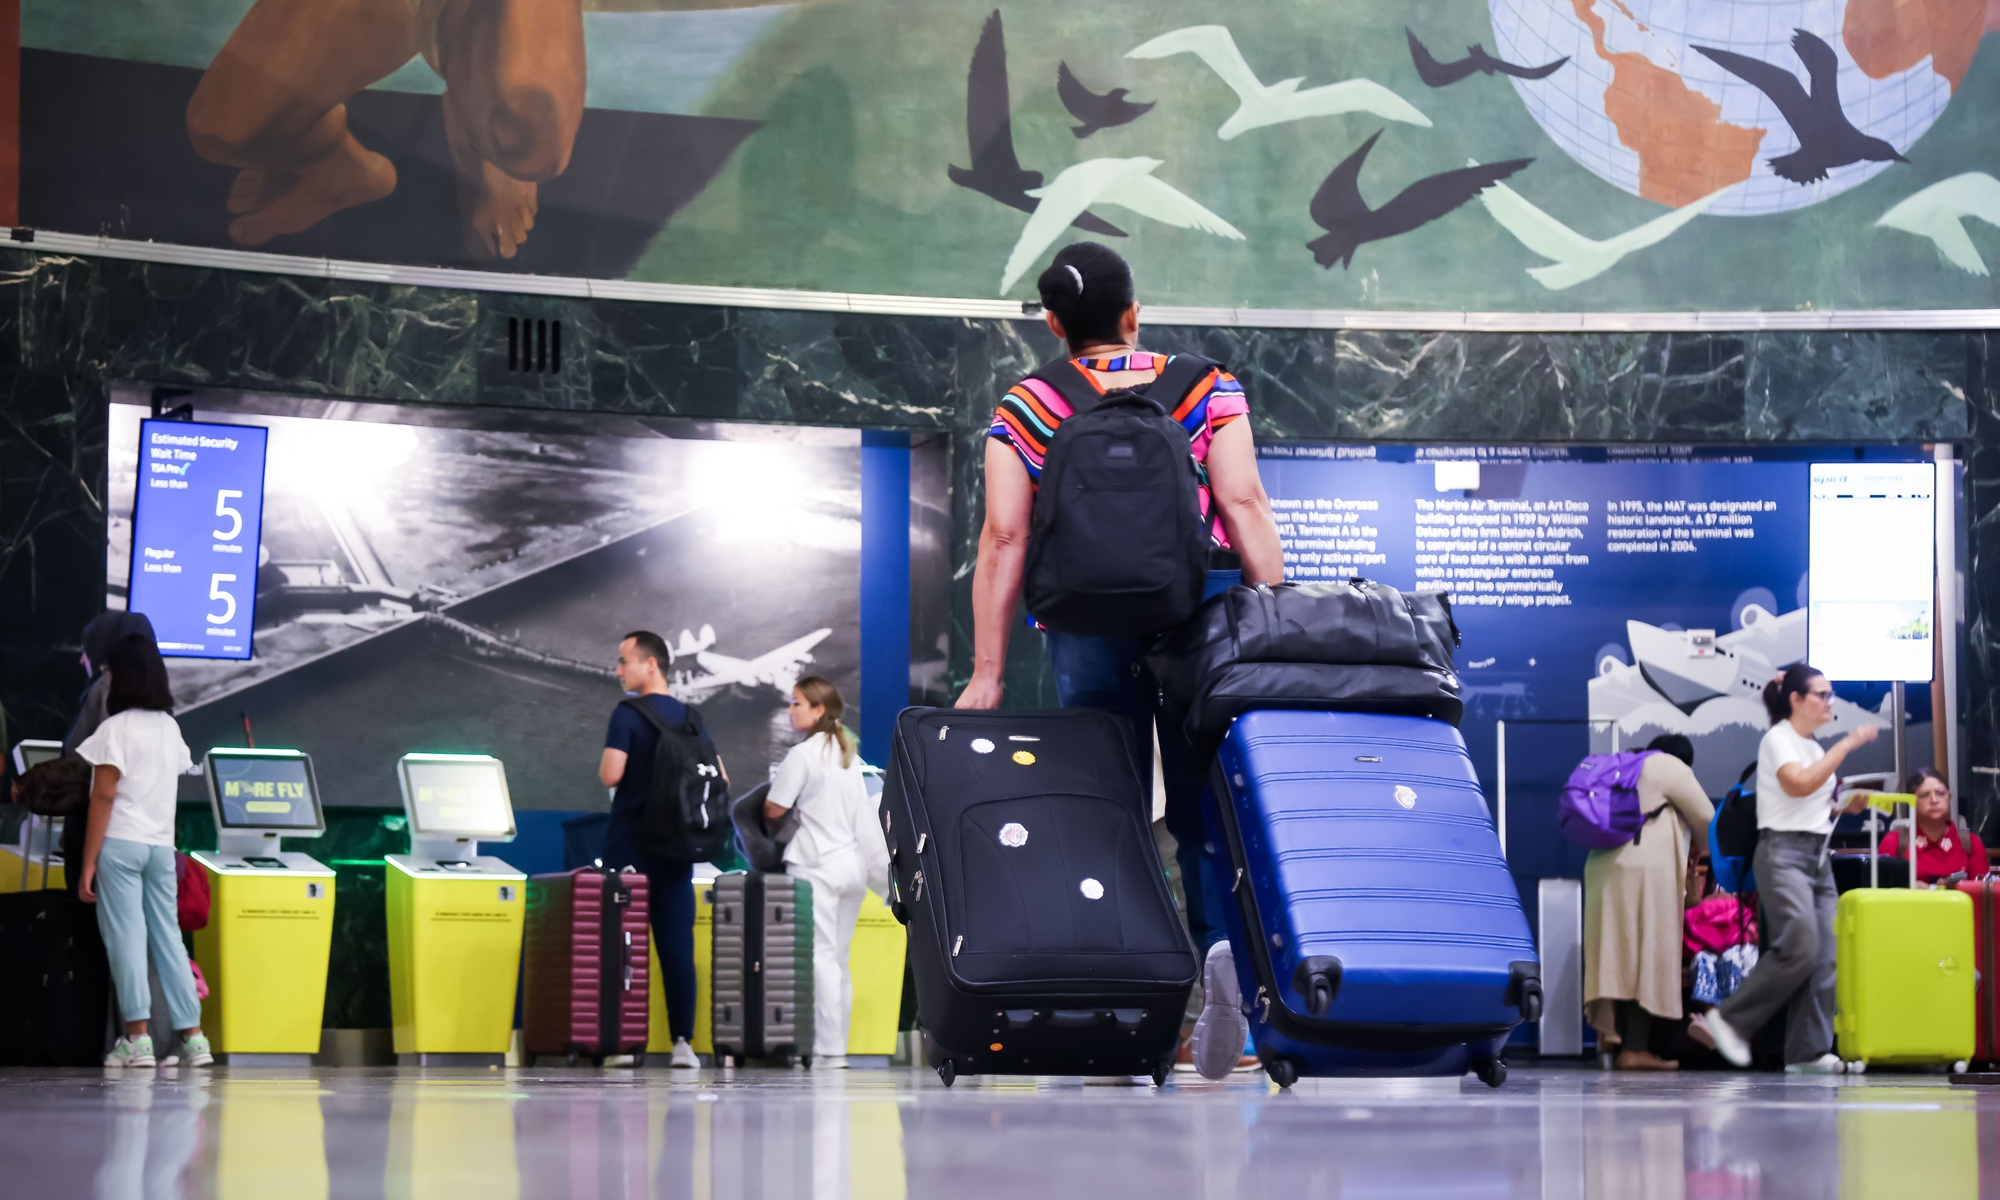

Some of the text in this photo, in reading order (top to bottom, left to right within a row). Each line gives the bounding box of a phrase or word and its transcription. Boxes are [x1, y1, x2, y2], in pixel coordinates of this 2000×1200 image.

[152, 432, 238, 451] Estimated Security
[150, 447, 197, 461] Wait Time
[150, 478, 188, 489] Less than
[1270, 498, 1378, 511] known as the Overseas
[1415, 499, 1589, 512] The Marine Air Terminal, an Art Deco
[1607, 500, 1776, 513] In 1995, the MAT was designated an
[212, 490, 242, 541] 5
[1291, 511, 1308, 523] the
[1309, 512, 1342, 523] Marine
[1344, 512, 1360, 523] Air
[1415, 512, 1588, 526] building designed in 1939 by William
[1607, 513, 1752, 526] historic landmark. A $7 million
[1298, 525, 1340, 536] Terminal
[1341, 526, 1350, 537] A
[1351, 526, 1360, 537] is
[1361, 525, 1378, 537] the
[1416, 526, 1583, 540] Delano of the firm Delano & Aldrich,
[1608, 527, 1754, 539] restoration of the terminal was
[212, 543, 243, 554] minutes
[1295, 538, 1335, 550] terminal
[1336, 538, 1376, 553] building
[1416, 540, 1571, 554] is comprised of a central circular
[1608, 541, 1697, 554] completed in 2004.
[144, 547, 176, 560] Regular
[1284, 552, 1386, 566] the only active airport
[1416, 554, 1589, 565] core of two stories with an attic from
[144, 562, 182, 574] Less than
[1296, 566, 1319, 576] from
[1321, 566, 1337, 577] the
[1338, 566, 1358, 577] first
[1415, 566, 1554, 580] which a rectangular entrance
[1416, 580, 1563, 594] pavilion and two symmetrically
[206, 573, 236, 624] 5
[1458, 594, 1504, 607] one-story
[1506, 595, 1534, 607] wings
[1536, 594, 1572, 607] project.
[206, 627, 236, 637] minutes
[277, 782, 304, 798] FLY
